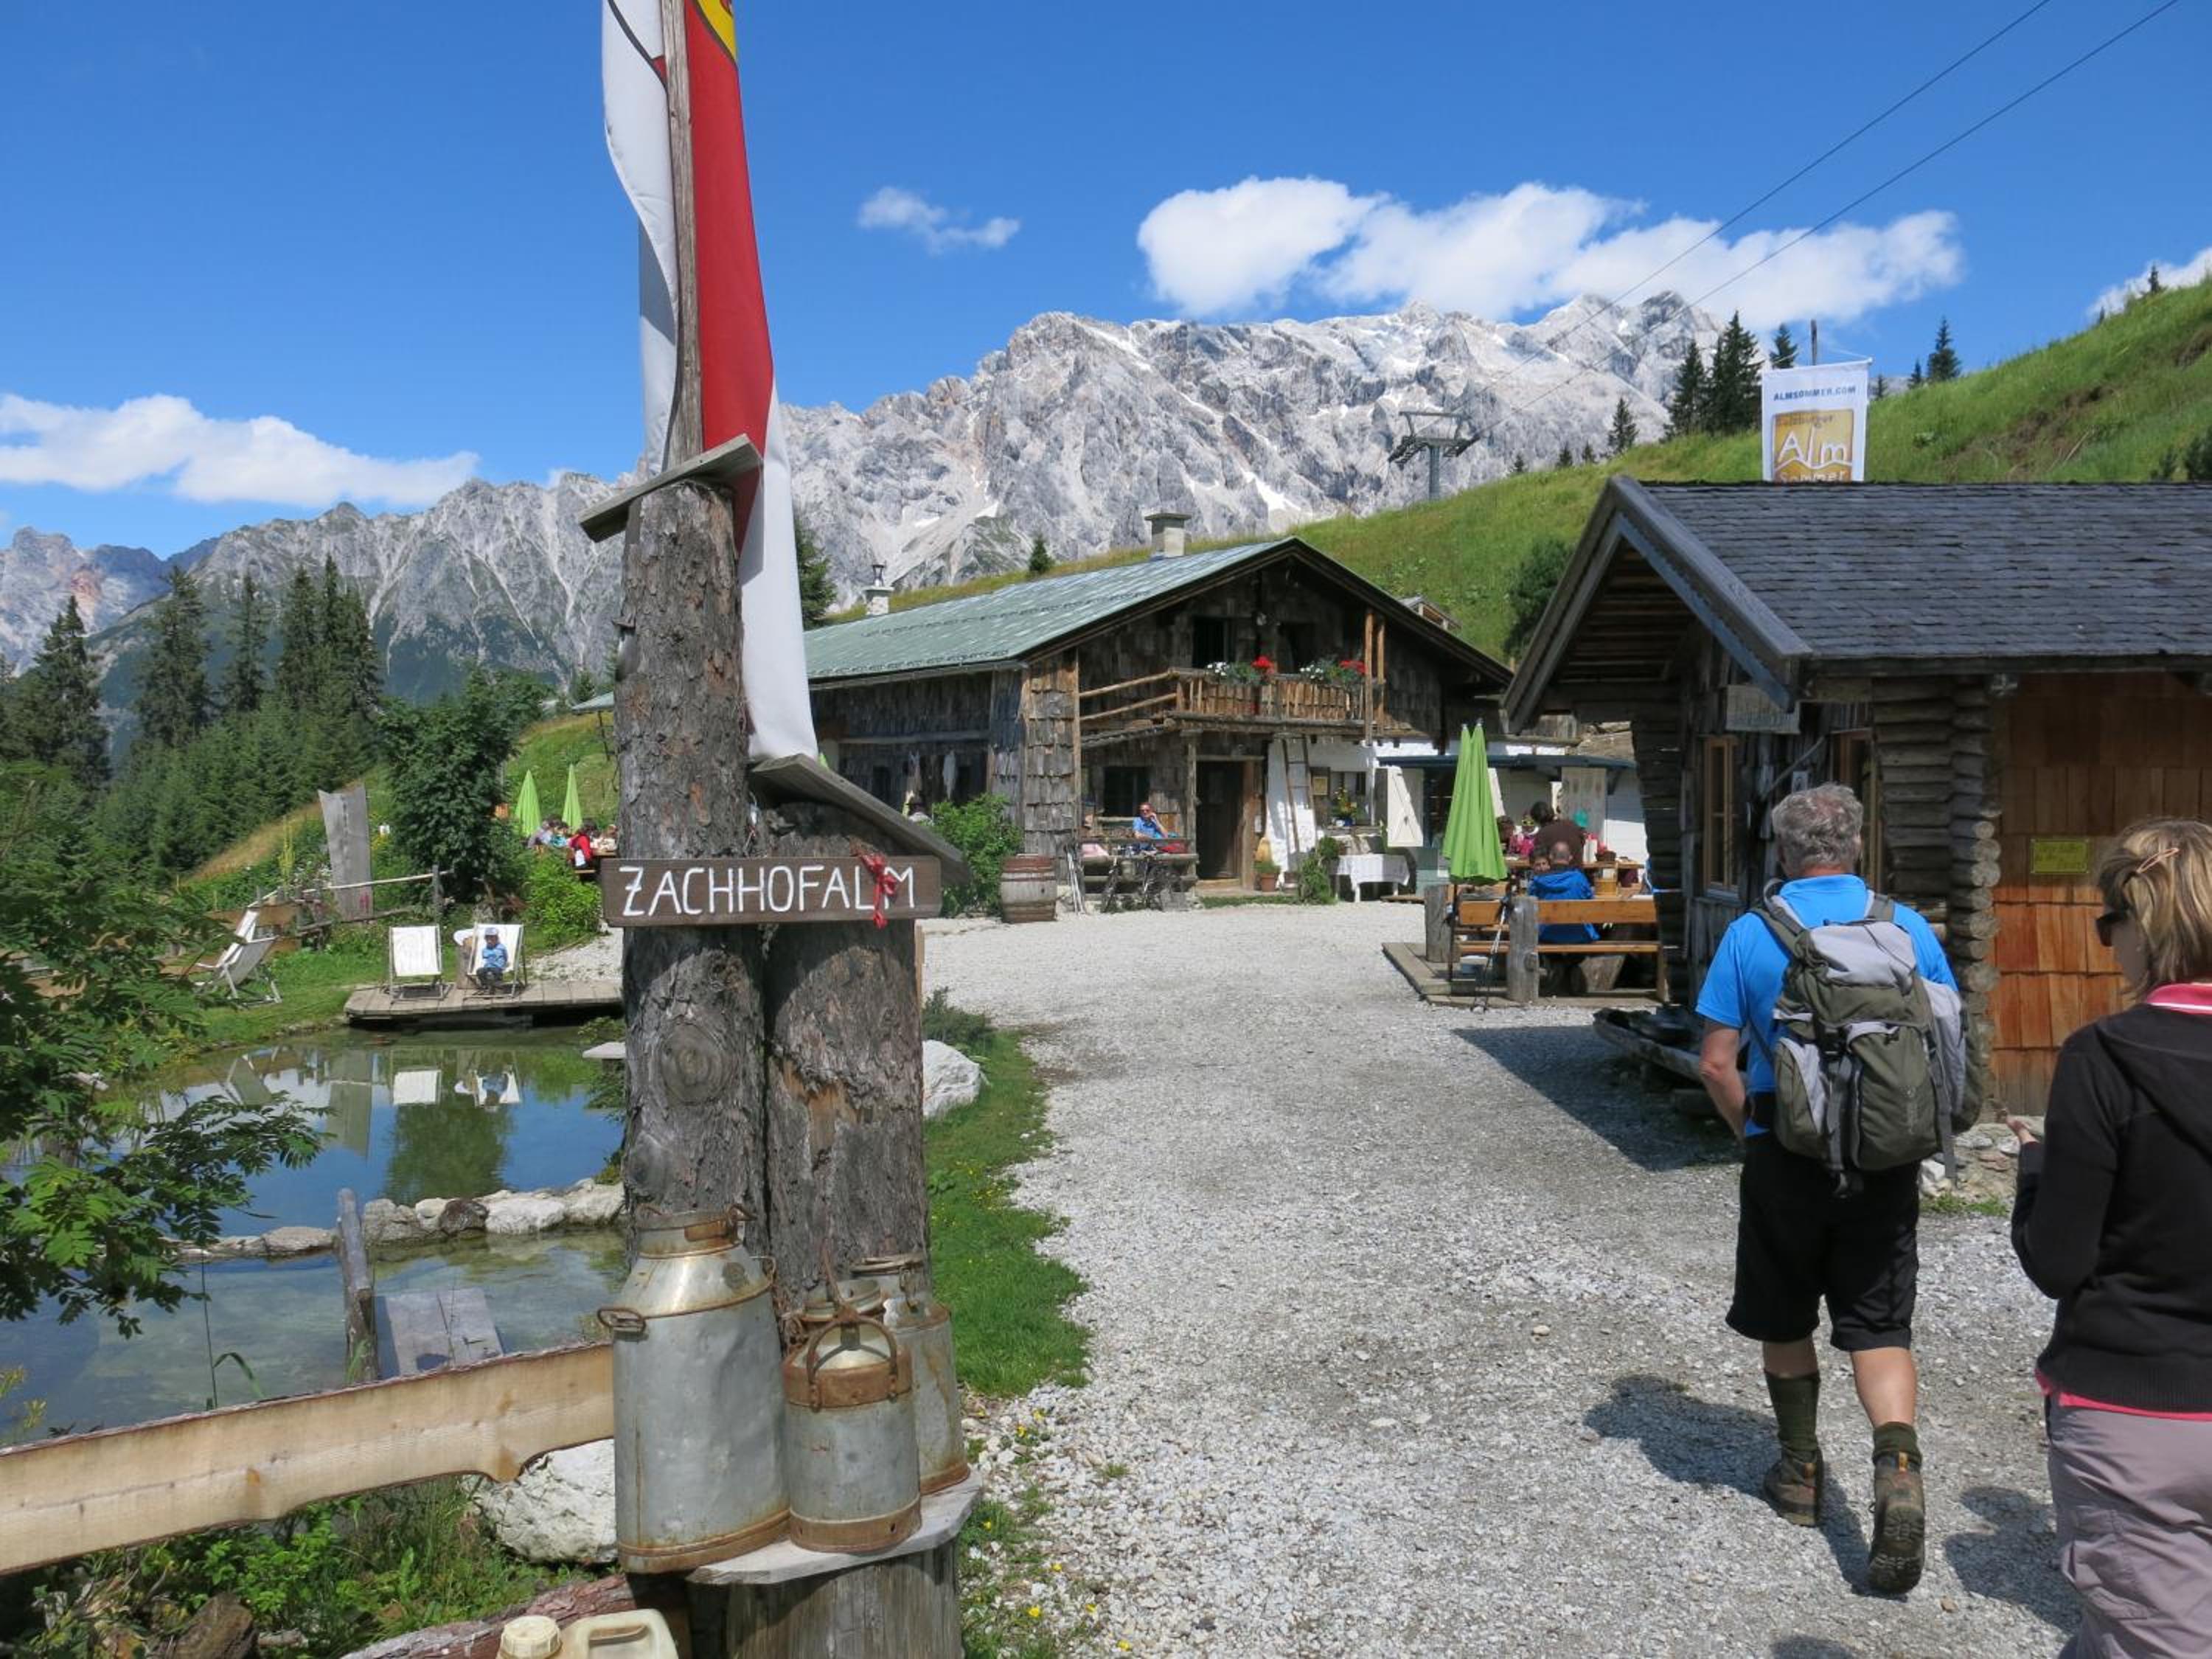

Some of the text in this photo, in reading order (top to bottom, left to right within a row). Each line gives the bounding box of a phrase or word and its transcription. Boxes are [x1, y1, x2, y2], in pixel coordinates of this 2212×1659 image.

[1773, 386, 1856, 400] ALMSOMMER.COM
[1777, 426, 1848, 466] Alm
[619, 865, 915, 917] ZACHHOFALM
